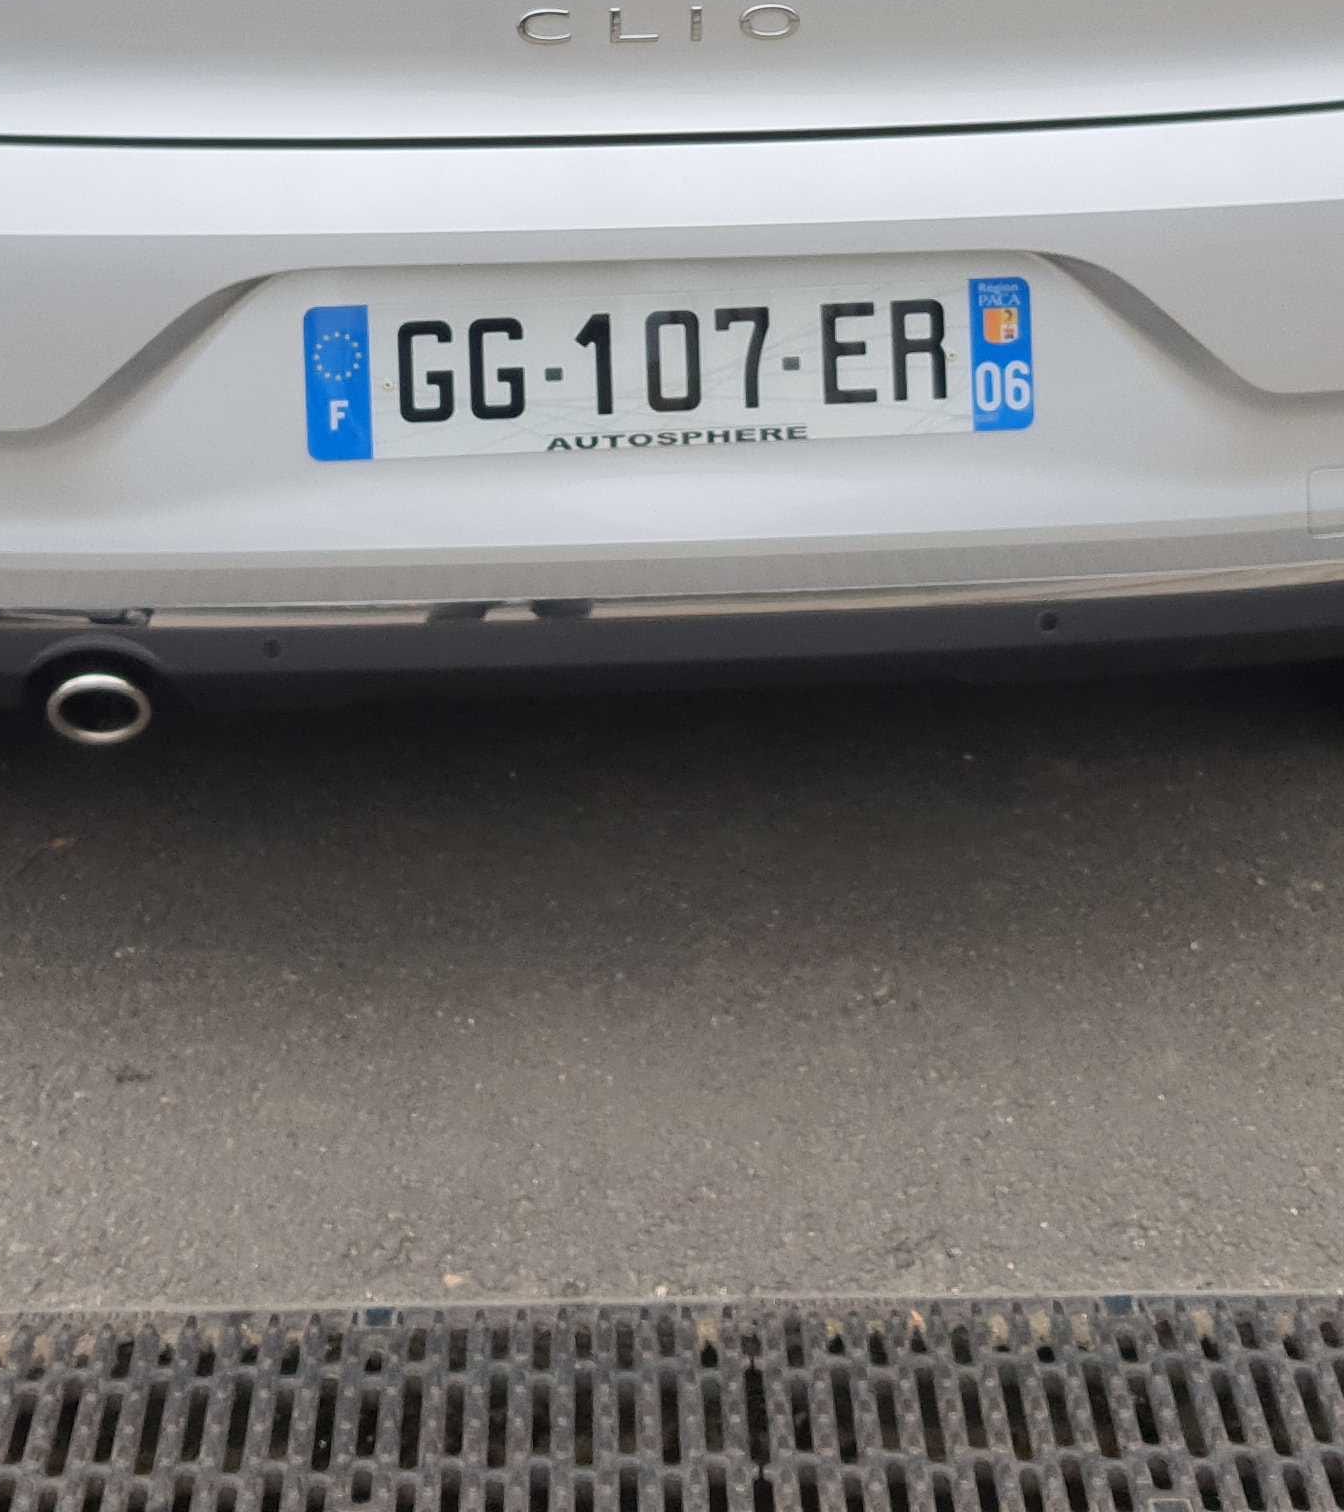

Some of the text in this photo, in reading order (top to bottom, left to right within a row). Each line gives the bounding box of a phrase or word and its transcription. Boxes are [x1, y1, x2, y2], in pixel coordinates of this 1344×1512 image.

[514, 3, 802, 46] CLIO
[975, 359, 1031, 412] 06
[329, 399, 349, 431] F
[545, 424, 809, 453] AUTOSPHERE
